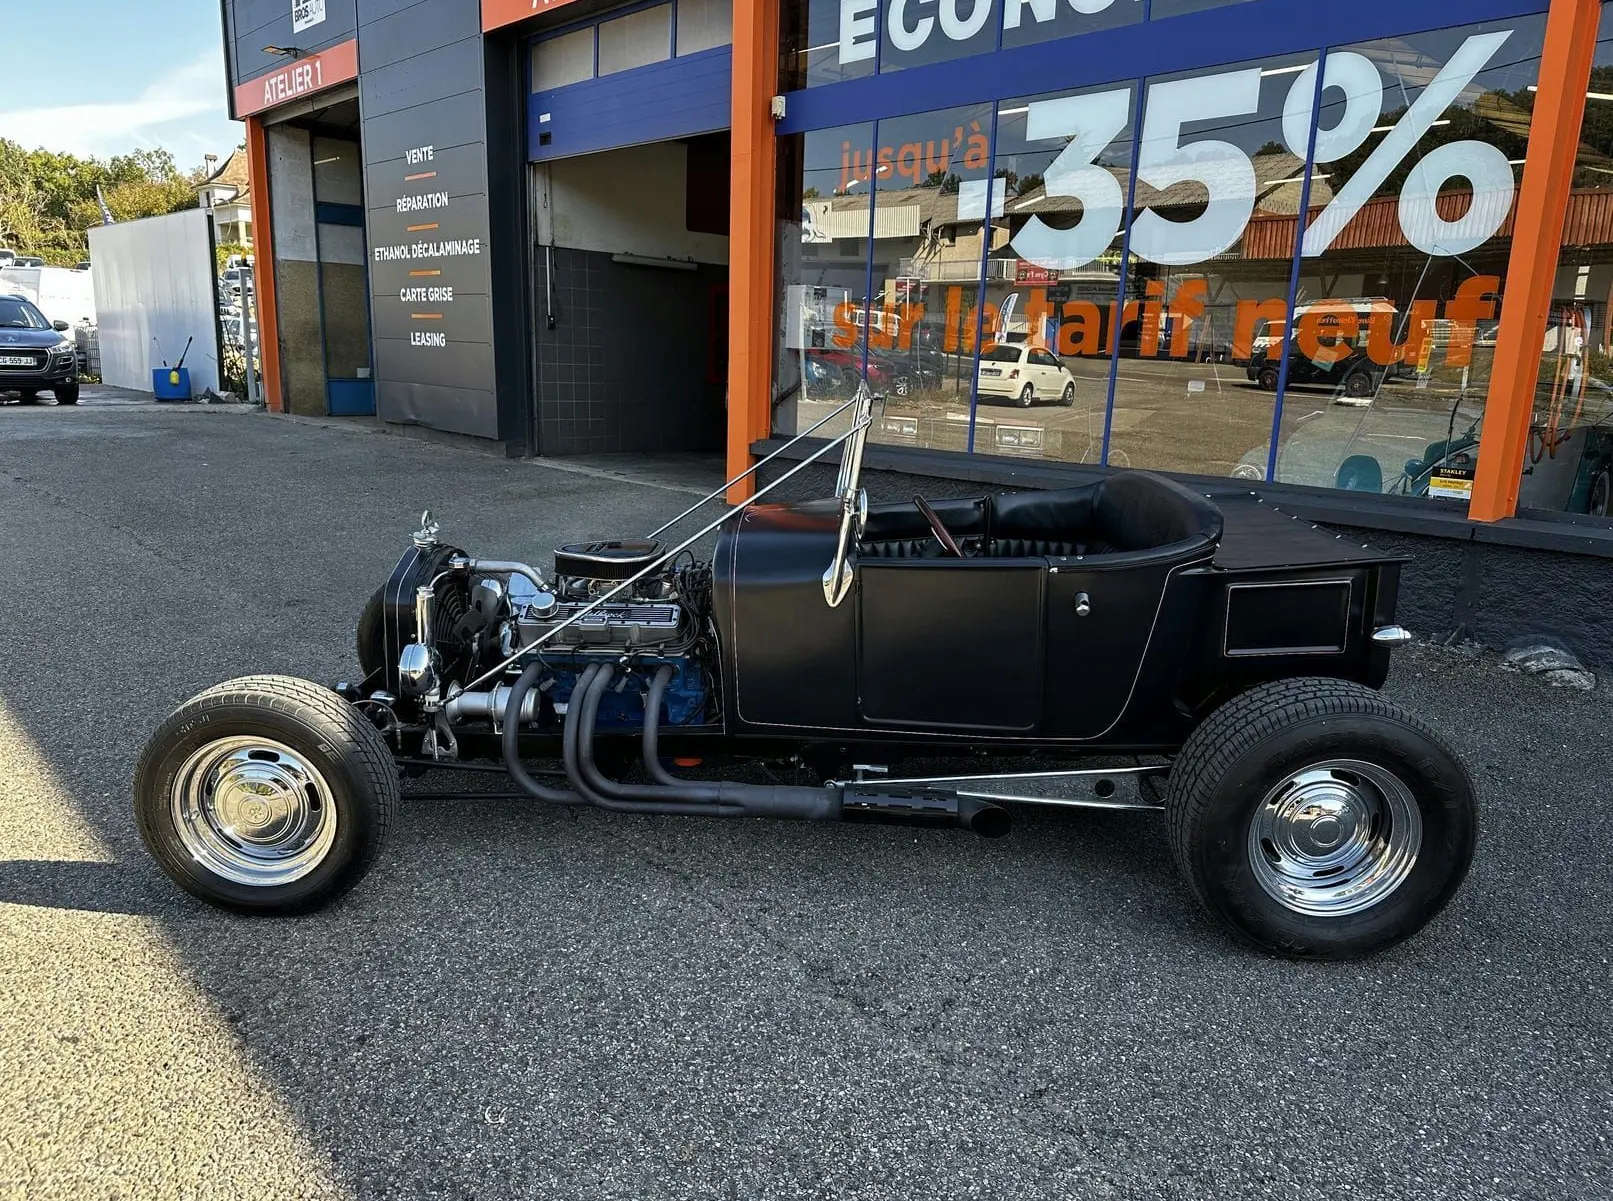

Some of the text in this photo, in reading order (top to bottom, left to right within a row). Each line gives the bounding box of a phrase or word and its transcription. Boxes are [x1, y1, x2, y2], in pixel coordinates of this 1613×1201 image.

[264, 60, 322, 104] ATELIER 1
[406, 146, 434, 164] VENTE
[396, 192, 449, 212] RÉPARATION
[374, 239, 480, 261] ETHANOL DÉCALAMINAGE
[400, 287, 453, 302] CARTE GRISE
[832, 300, 927, 351] sur
[943, 287, 1002, 354] le
[1024, 278, 1206, 358] tarif
[1231, 276, 1500, 366] neuf
[411, 332, 446, 347] LEASING
